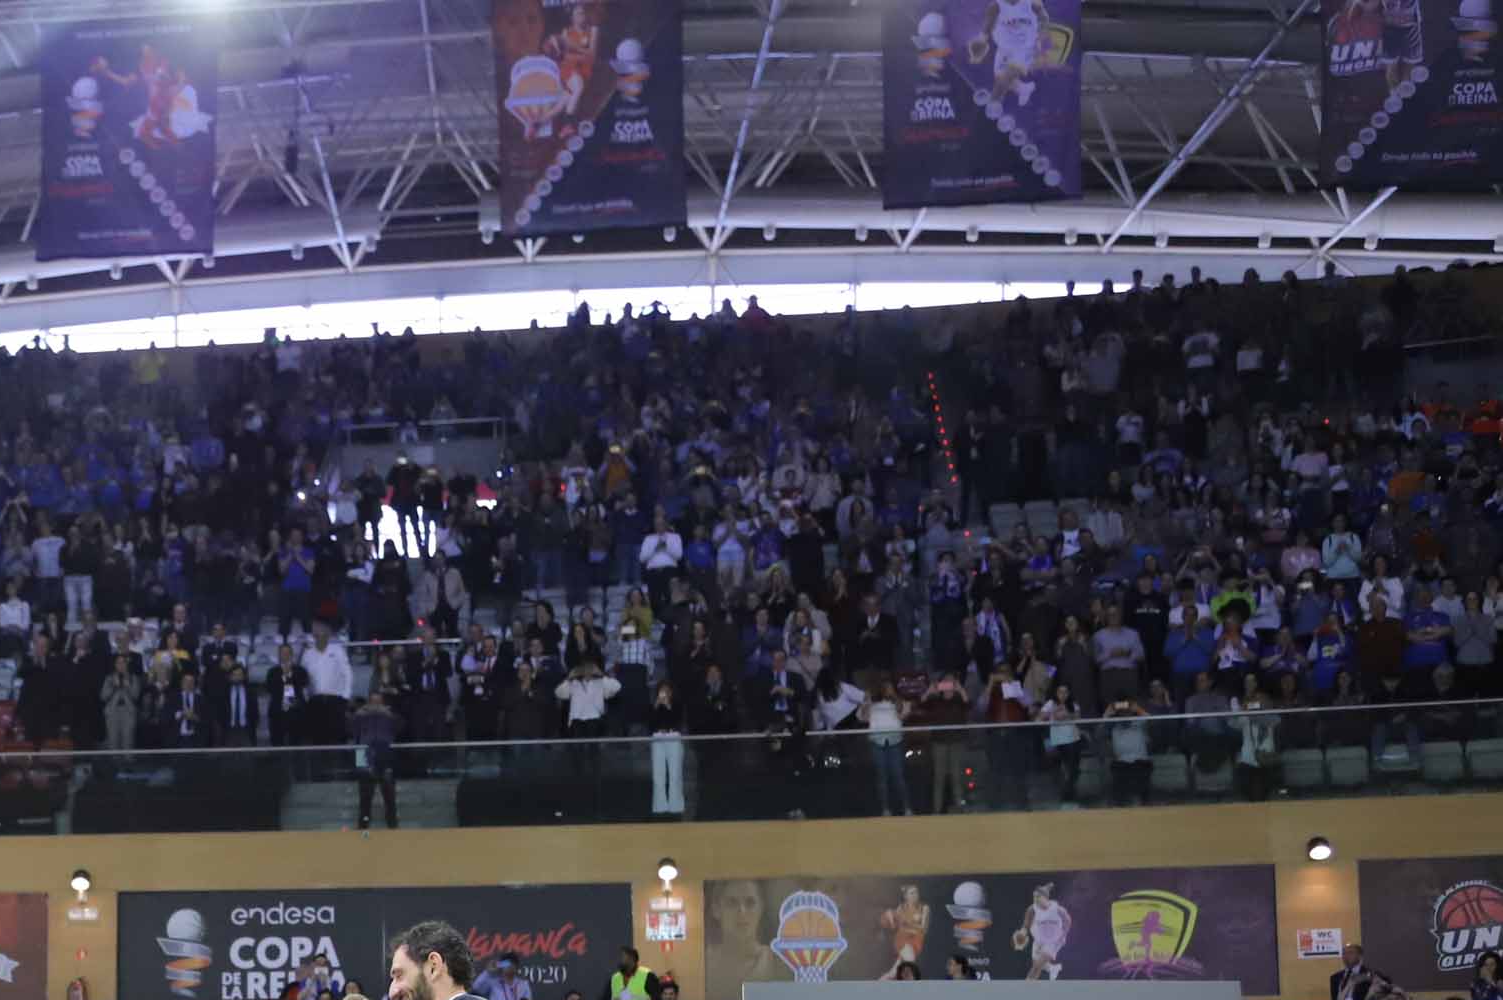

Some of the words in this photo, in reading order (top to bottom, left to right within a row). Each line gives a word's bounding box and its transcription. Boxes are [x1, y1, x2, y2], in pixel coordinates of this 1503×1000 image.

[230, 902, 335, 926] endesa
[229, 936, 340, 970] COPA
[221, 972, 241, 986] DE
[221, 986, 244, 1000] LA
